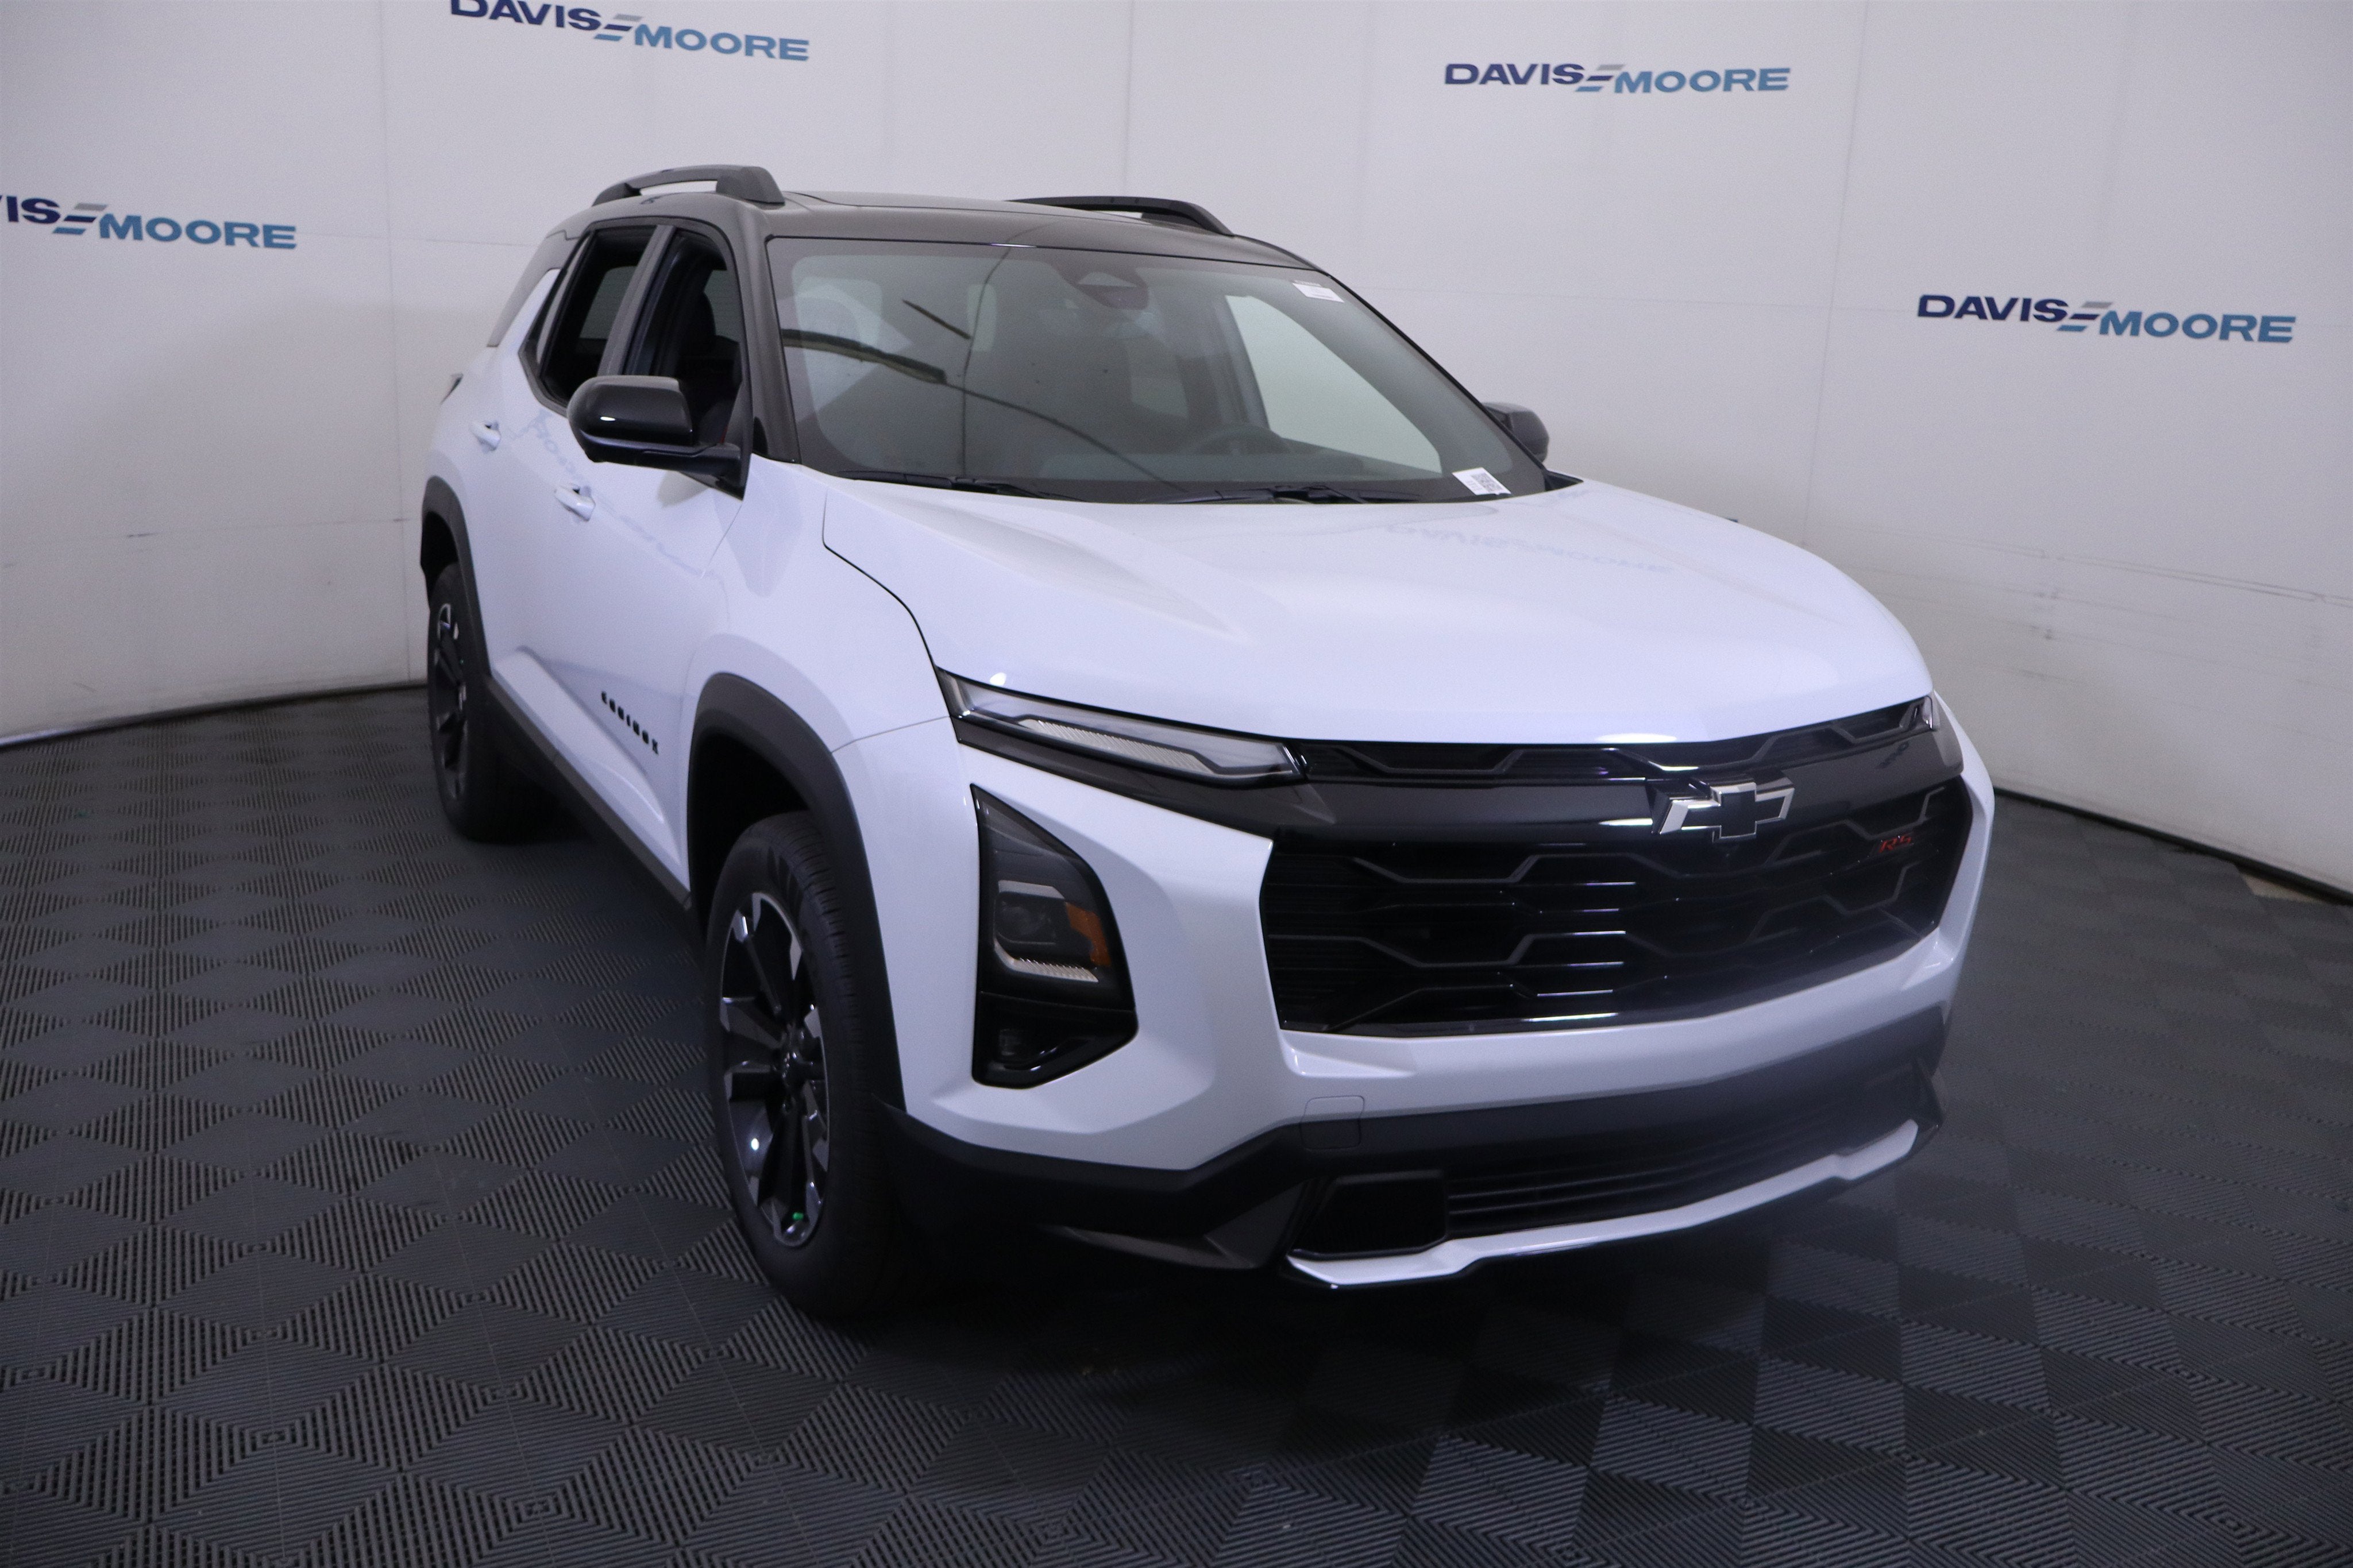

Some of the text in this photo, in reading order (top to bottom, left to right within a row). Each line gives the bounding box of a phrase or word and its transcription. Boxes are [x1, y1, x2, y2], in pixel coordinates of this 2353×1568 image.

[450, 0, 809, 61] DAVIS MOORE
[1444, 63, 1791, 94] DAVIS MOORE
[0, 195, 297, 250] IS MOORE
[1916, 293, 2297, 344] DAVIS MOORE
